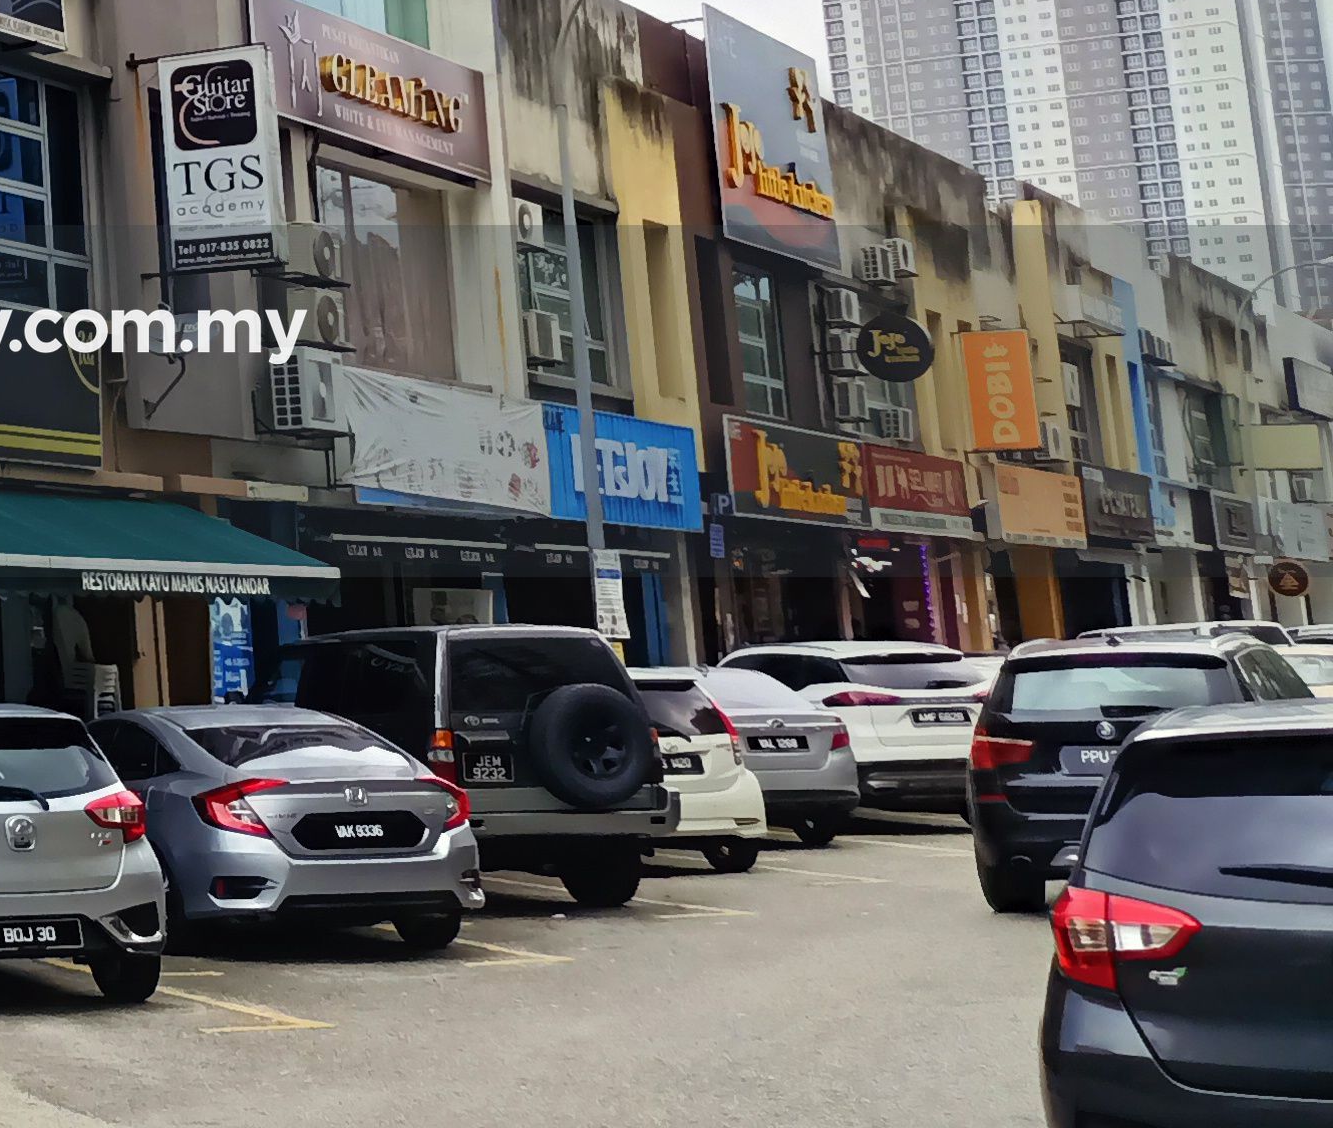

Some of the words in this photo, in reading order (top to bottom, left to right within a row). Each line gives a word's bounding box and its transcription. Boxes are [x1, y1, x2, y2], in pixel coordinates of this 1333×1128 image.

[174, 74, 250, 99] Guitar
[193, 94, 246, 115] Store
[173, 154, 263, 196] TGS
[177, 199, 265, 217] academy
[81, 572, 141, 591] RESTORAN
[141, 574, 169, 592] KAYU
[171, 575, 204, 593] MANIS
[205, 576, 229, 594] NASI
[230, 577, 270, 595] KANDAR
[1081, 750, 1109, 763] PPU
[473, 767, 506, 780] 9232
[36, 926, 56, 941] 30
